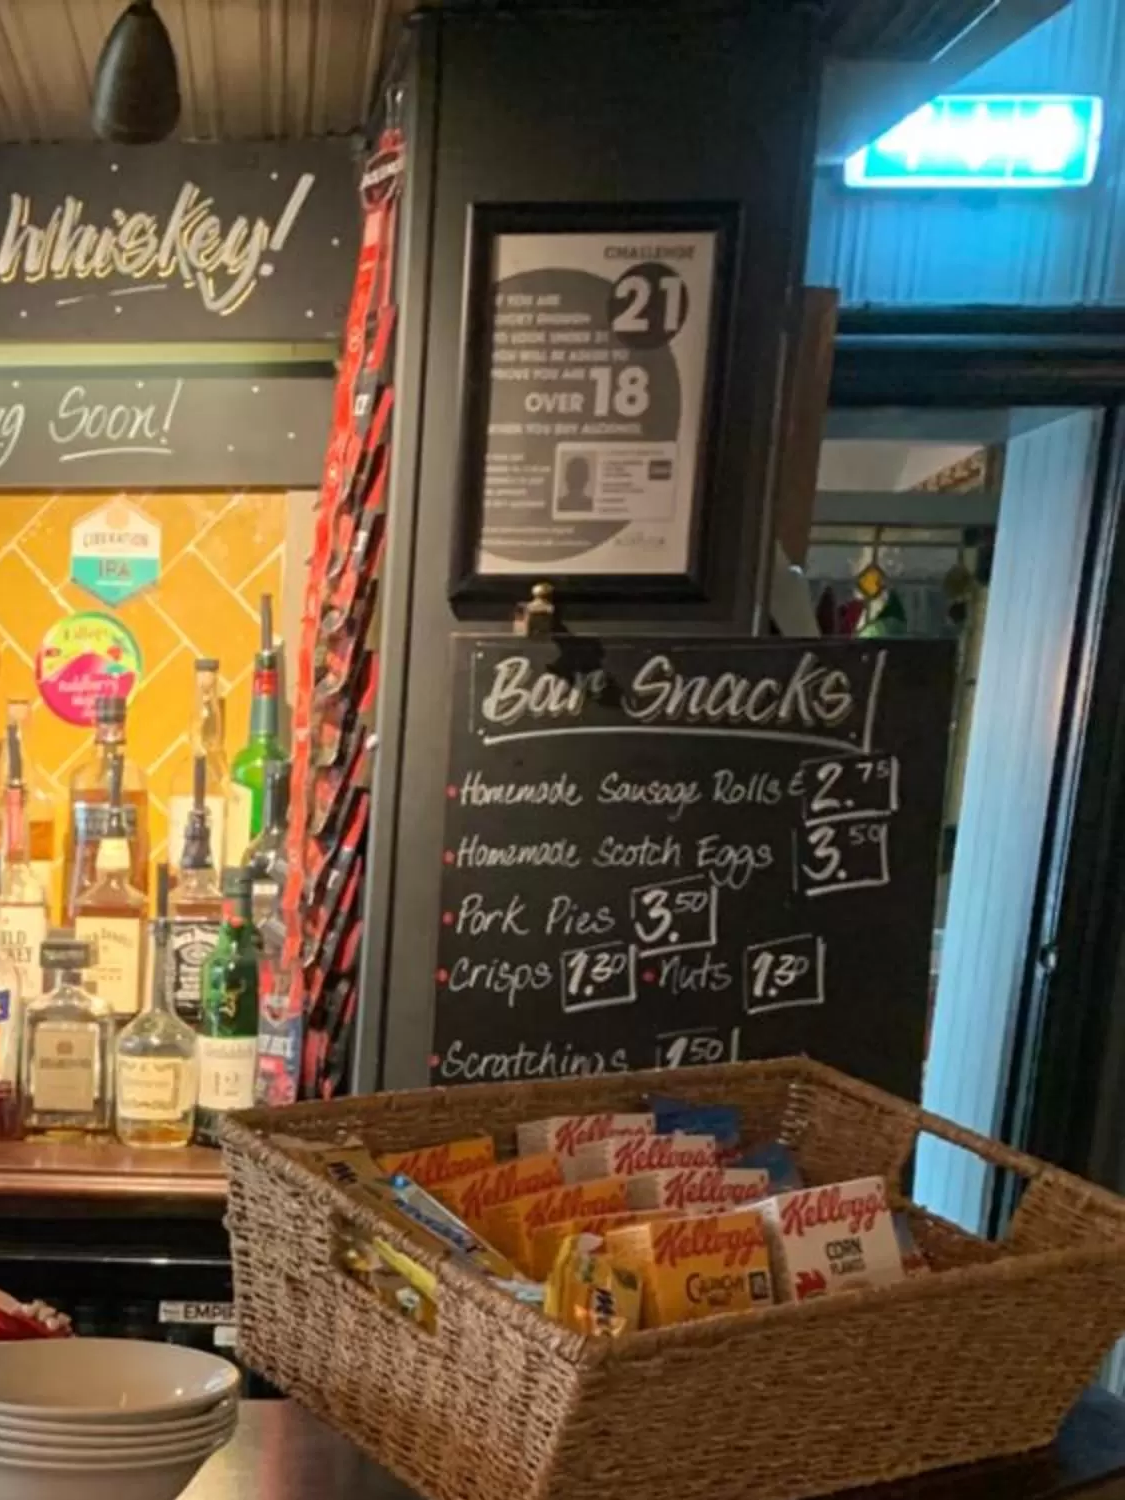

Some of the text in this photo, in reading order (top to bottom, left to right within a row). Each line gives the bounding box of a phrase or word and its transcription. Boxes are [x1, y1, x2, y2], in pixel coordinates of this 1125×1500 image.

[612, 275, 682, 333] 21
[49, 379, 182, 444] Soon!
[525, 365, 650, 417] OVER 18
[482, 654, 852, 724] Bar Snacks
[460, 771, 584, 806] Homemade
[597, 771, 702, 822] Sausage
[713, 770, 782, 805] Rolls
[455, 836, 582, 868] Homemade
[592, 834, 681, 867] Scotch
[696, 834, 774, 889] Eggs
[455, 893, 529, 936] Pork
[546, 894, 616, 935] Pies
[448, 957, 553, 1007] Crisps
[782, 1183, 889, 1237] Kellogg's
